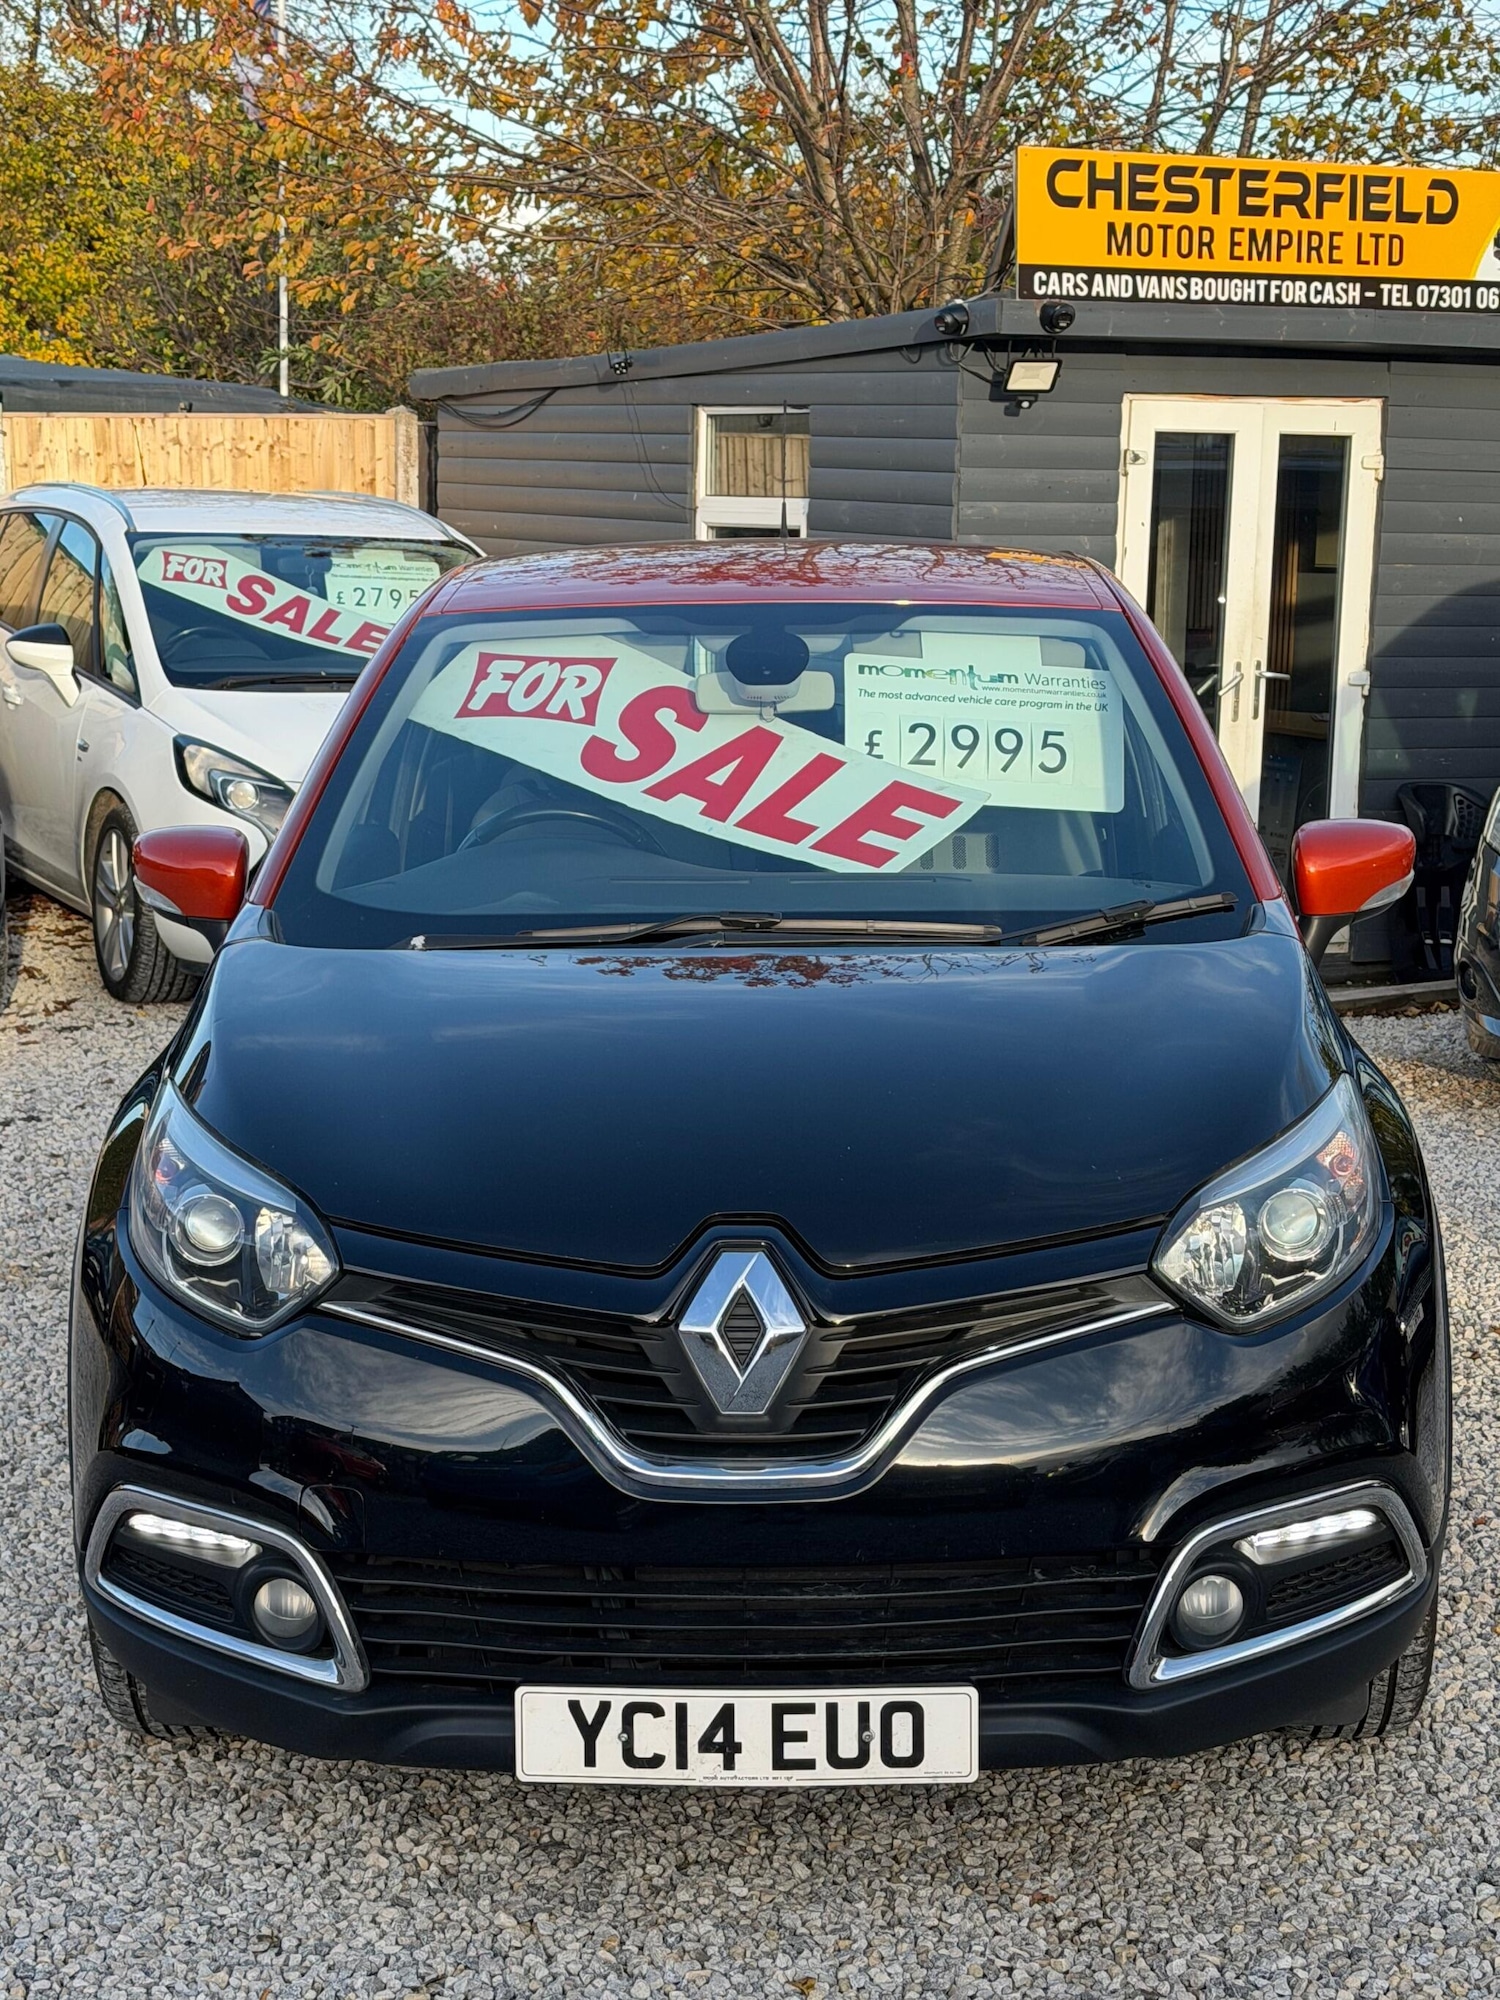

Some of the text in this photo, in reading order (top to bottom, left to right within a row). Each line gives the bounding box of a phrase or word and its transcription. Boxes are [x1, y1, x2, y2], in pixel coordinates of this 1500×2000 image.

[1046, 158, 1459, 225] CHESTERFIELD
[1106, 221, 1404, 267] MOTOR EMPIRE LTD
[1033, 271, 1089, 296] CARS
[1091, 273, 1133, 298] AND
[1136, 275, 1188, 300] VANS
[1190, 277, 1268, 303] BOUGHT
[1270, 279, 1307, 304] FOR
[1309, 281, 1362, 306] CASH
[1379, 283, 1413, 307] TEL
[1416, 285, 1471, 309] 07301
[1476, 287, 1500, 310] 06
[165, 555, 391, 653] FOR SALE
[858, 664, 1107, 691] momentum Warranties
[858, 688, 1109, 712] The most advanced vehicle care program in the UK
[982, 685, 1107, 698] www.momentumwarranties.co.uk
[469, 659, 963, 869] FOR SALE
[864, 722, 1067, 774] £ 2995
[568, 1699, 925, 1771] YC14 EUO
